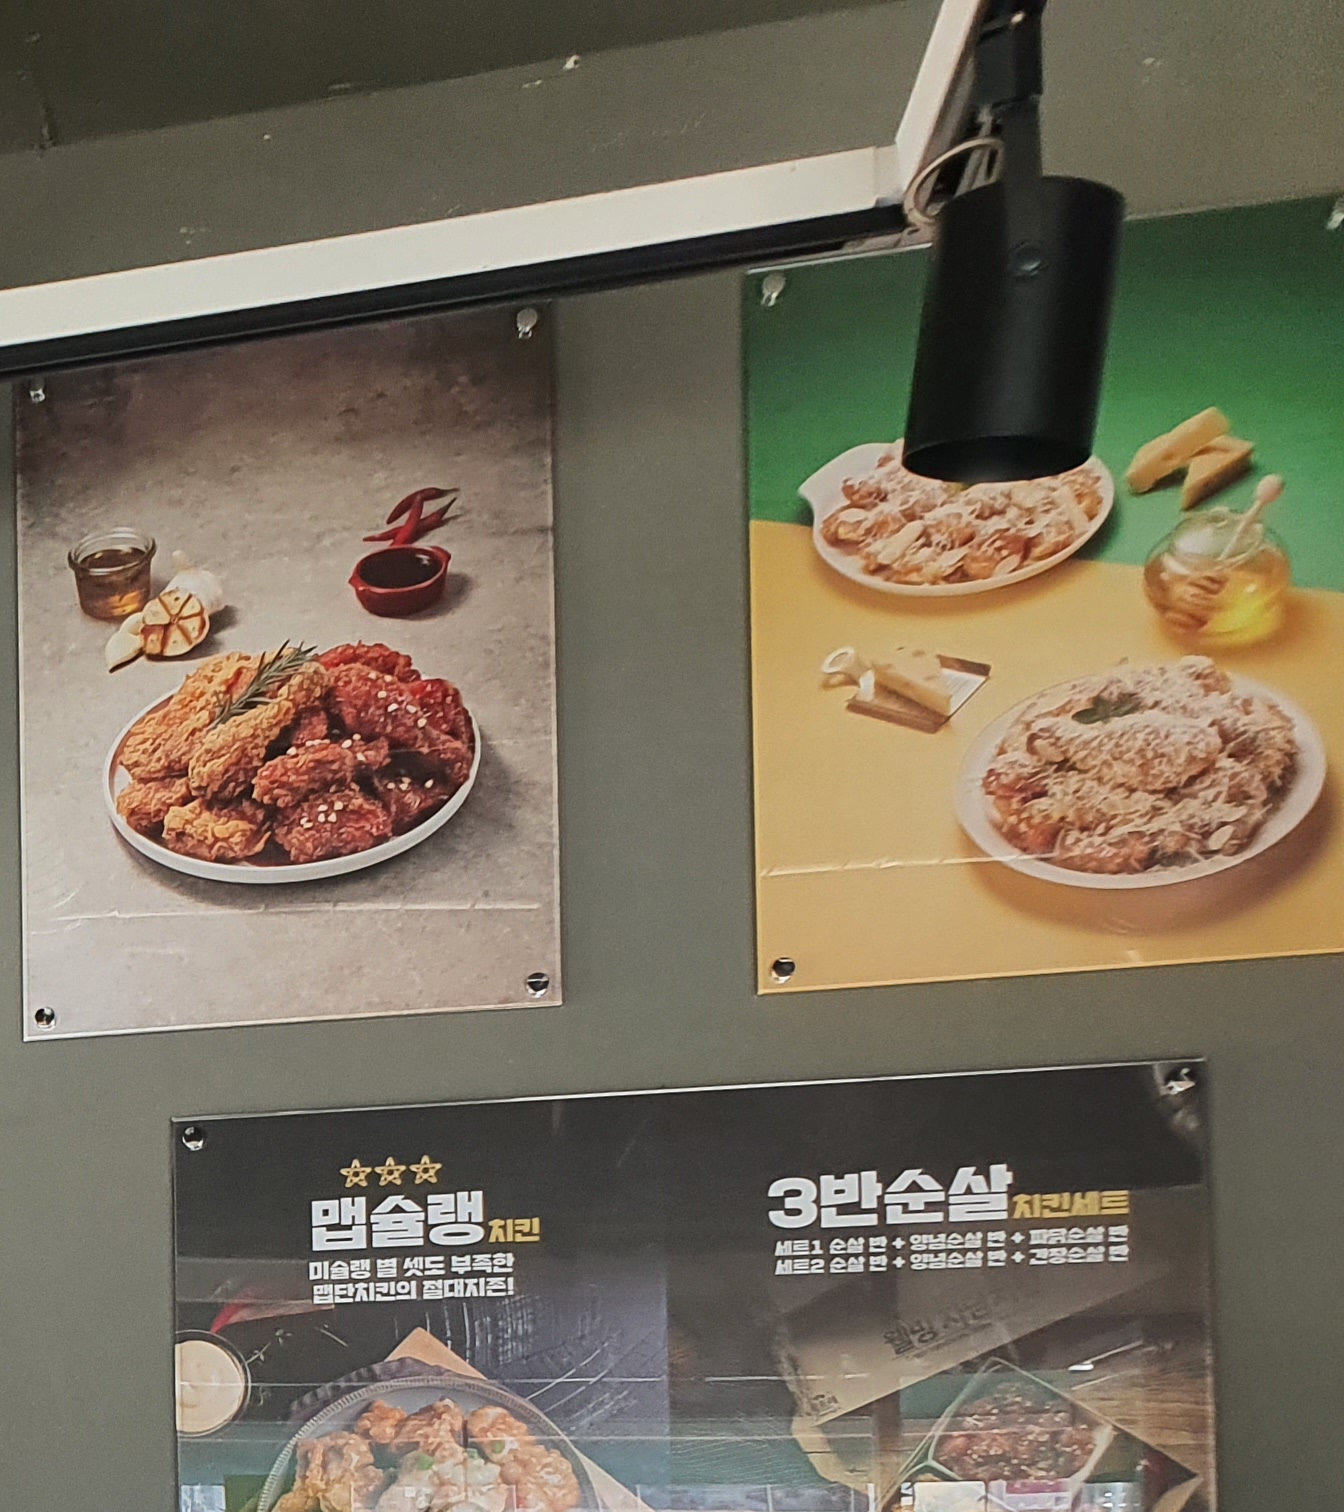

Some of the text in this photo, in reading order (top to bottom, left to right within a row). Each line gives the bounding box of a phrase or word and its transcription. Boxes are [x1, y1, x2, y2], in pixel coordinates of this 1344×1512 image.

[768, 1163, 1130, 1229] 3반순살 치킨세트
[311, 1190, 541, 1251] 맵슐랭 치킨
[775, 1239, 822, 1256] 세트1
[829, 1237, 864, 1255] 순살
[869, 1235, 888, 1254] 반
[910, 1231, 983, 1251] 양념순살
[987, 1230, 1007, 1248] 반
[1108, 1224, 1130, 1242] 반
[309, 1253, 515, 1280] 미슐랭 별 셋도 부족한
[775, 1259, 824, 1275] 세트2
[829, 1256, 864, 1273] 순살
[869, 1255, 888, 1272] 반
[910, 1251, 983, 1270] 양념순살
[987, 1249, 1007, 1268] 반
[1029, 1245, 1105, 1264] 간장순살
[1108, 1244, 1130, 1262] 반
[313, 1277, 514, 1304] 맵단치킨의 절대지존!
